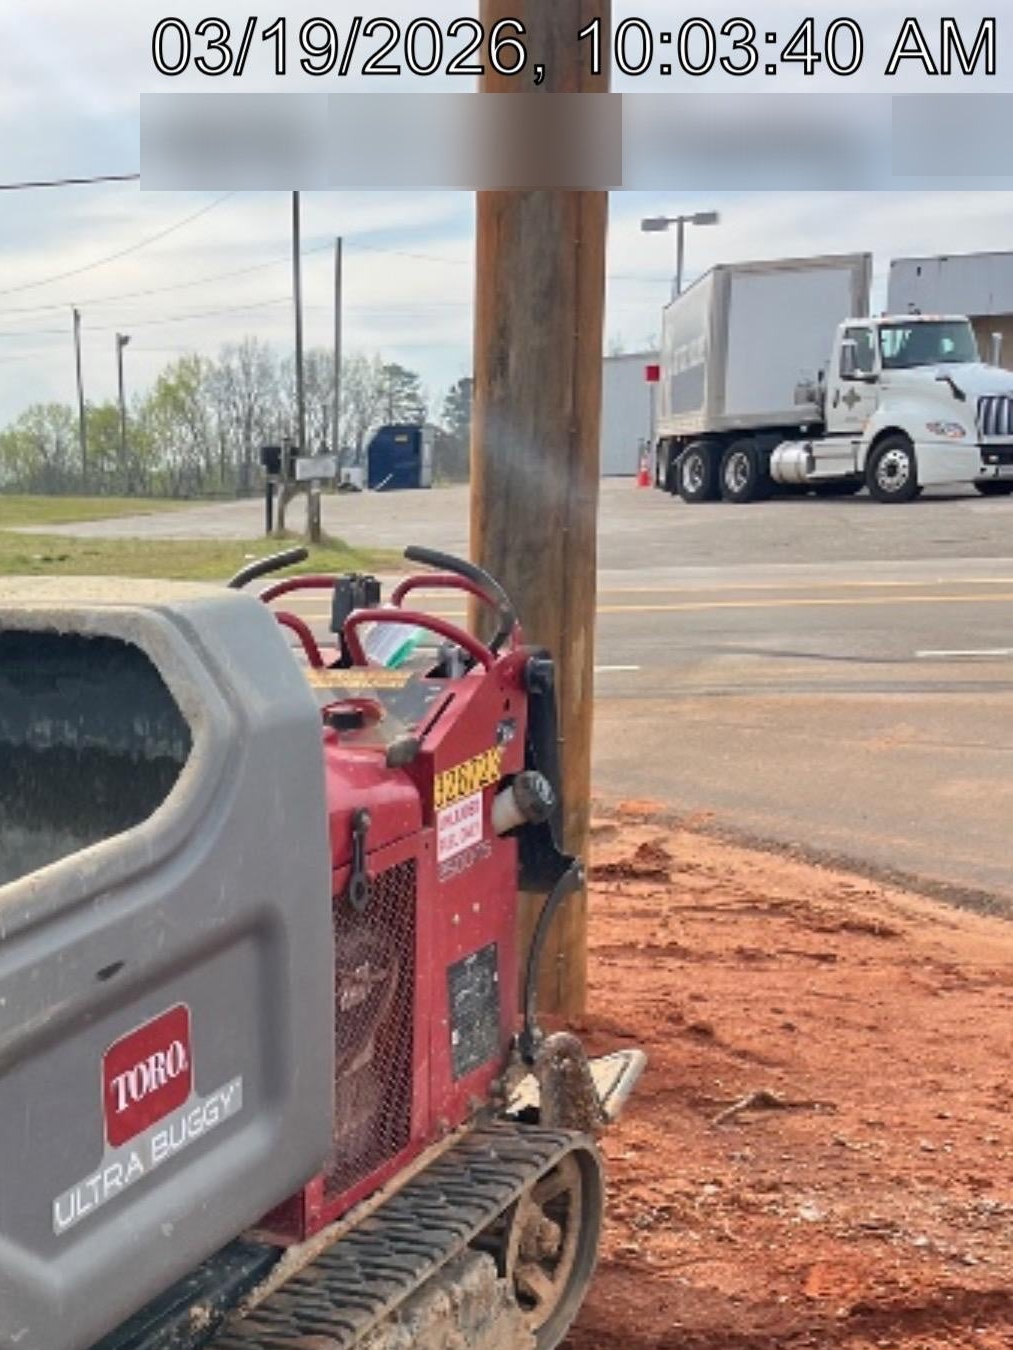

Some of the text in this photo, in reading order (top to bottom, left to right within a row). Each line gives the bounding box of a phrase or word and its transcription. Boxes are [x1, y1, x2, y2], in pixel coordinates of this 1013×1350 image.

[110, 1041, 186, 1114] TORO
[54, 1086, 237, 1227] ULTRA BUGGY
